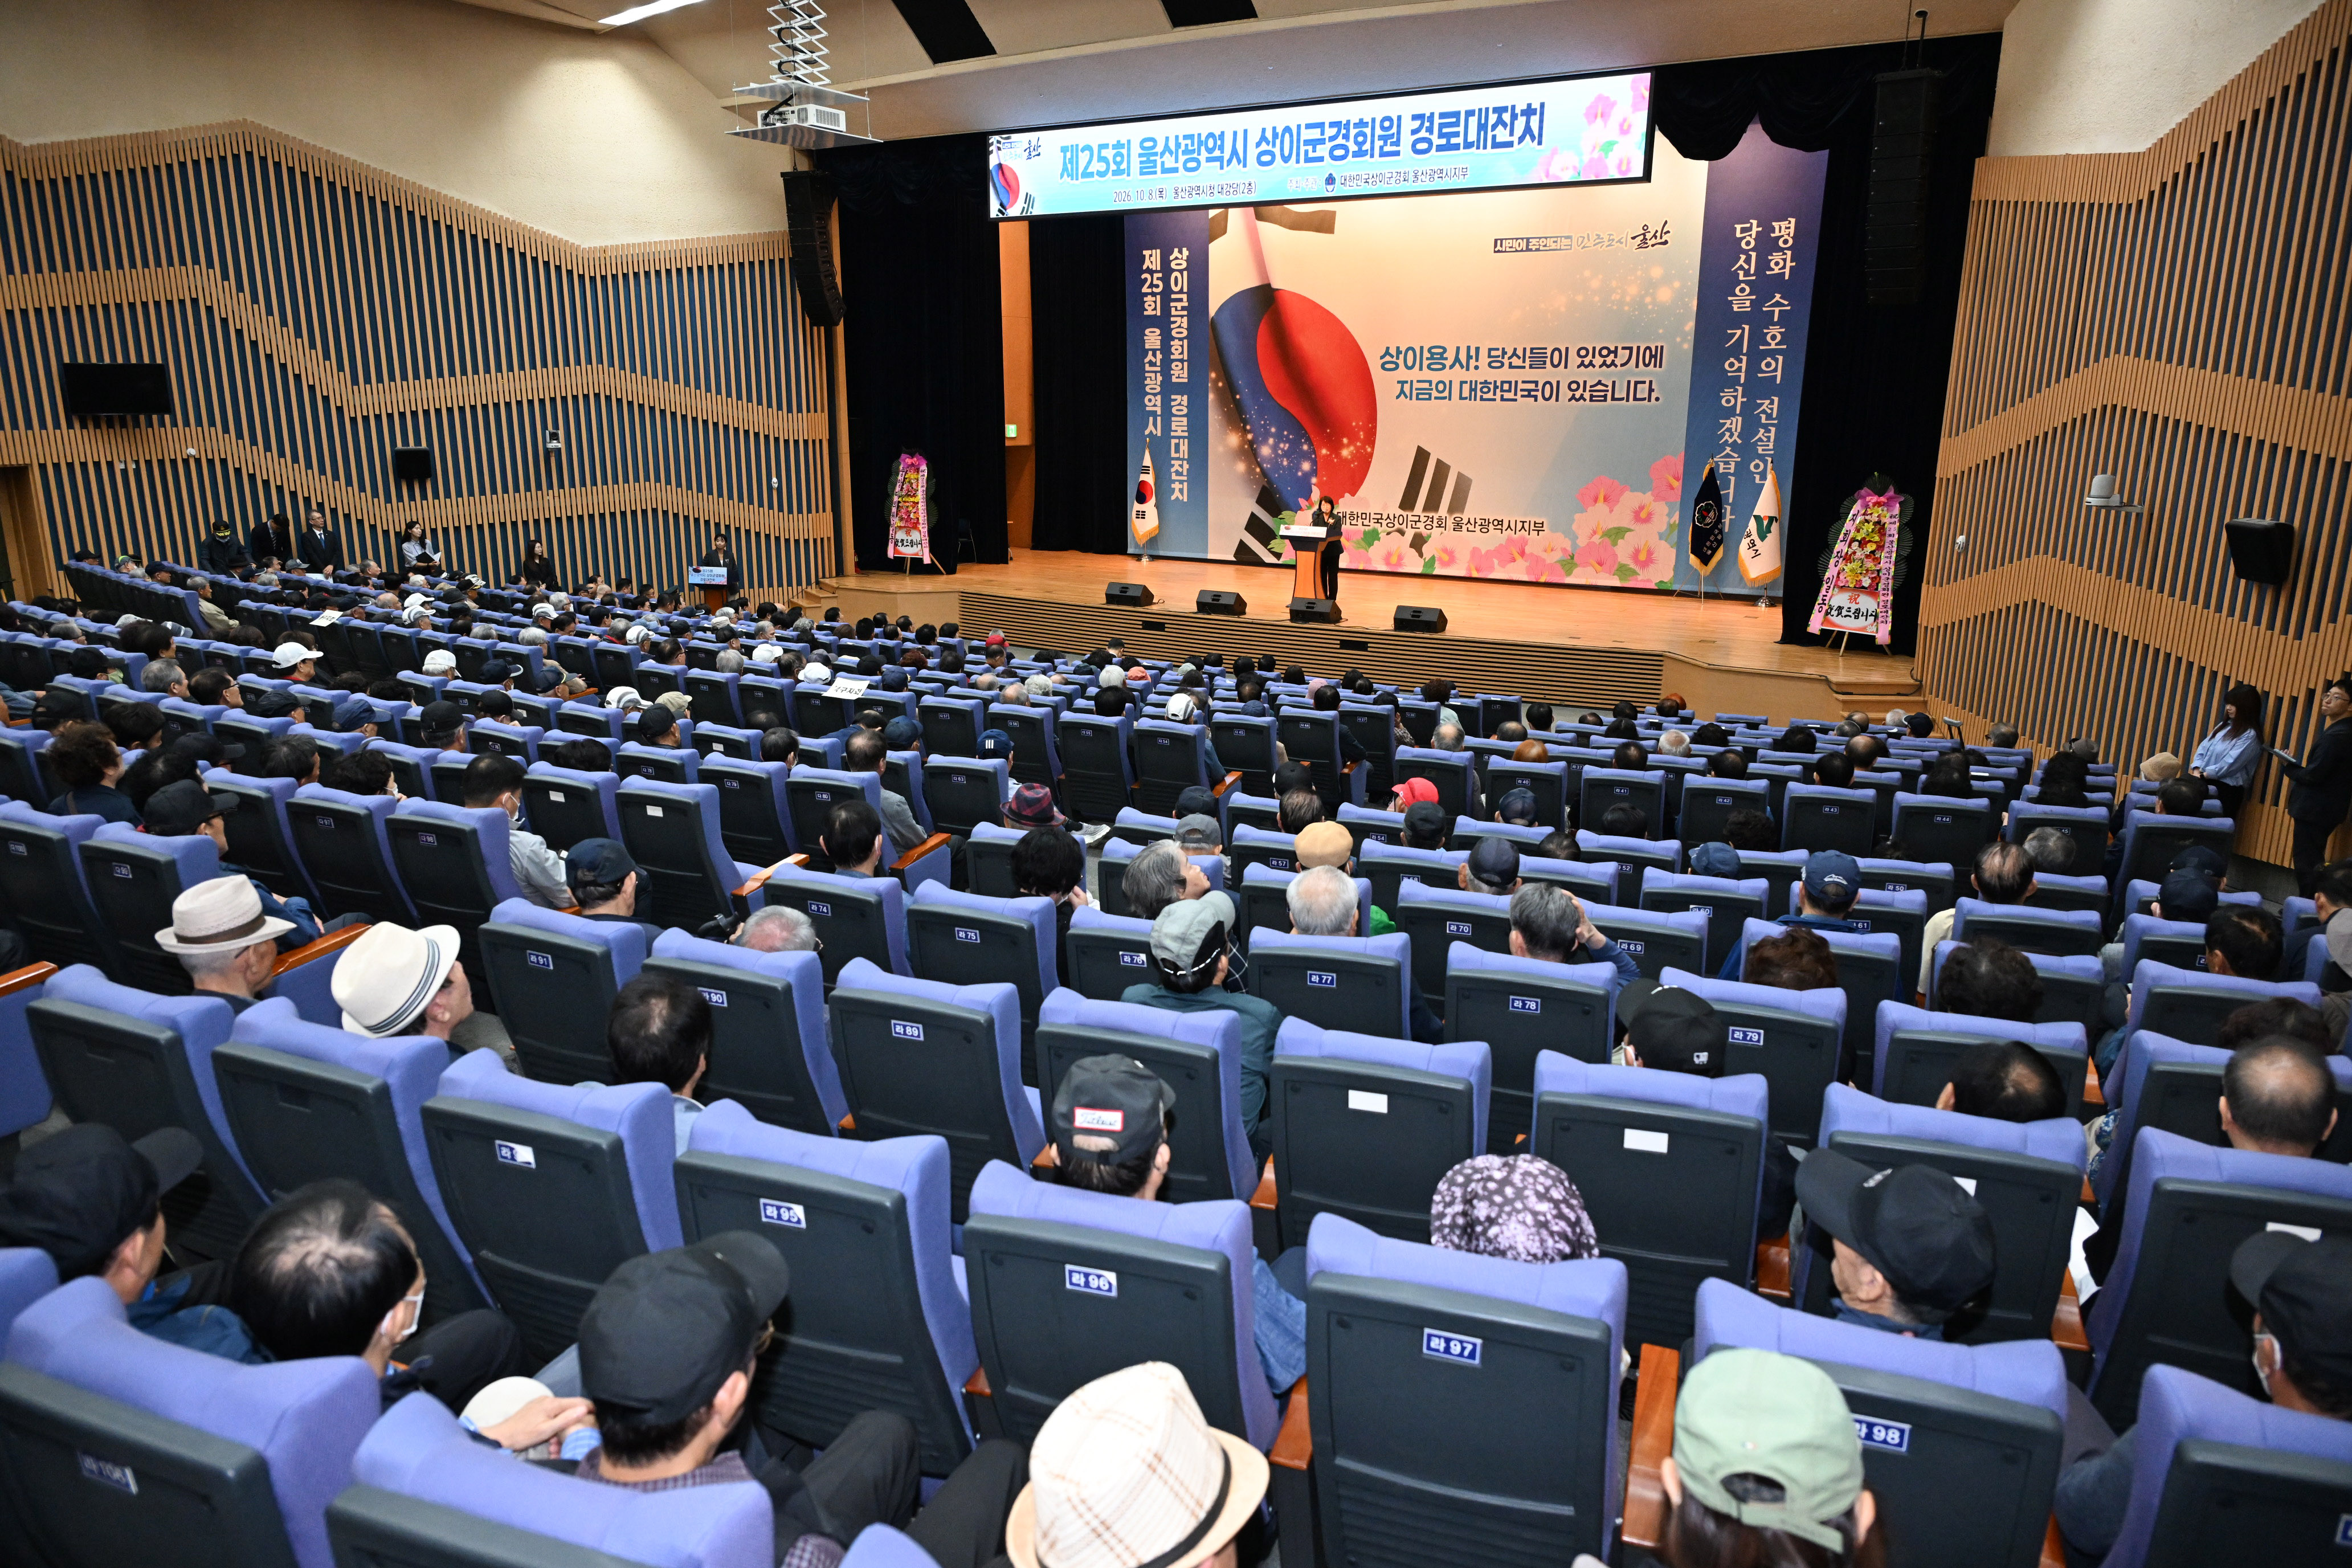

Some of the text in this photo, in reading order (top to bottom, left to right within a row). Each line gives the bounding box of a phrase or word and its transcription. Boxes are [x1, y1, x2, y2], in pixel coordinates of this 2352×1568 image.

[1060, 102, 1546, 181] 제25회 울산광역시 상이군경회원 경로대잔치
[1340, 170, 1409, 187] 대한민국상이군경회
[1412, 166, 1468, 183] 울산광역시지부
[1114, 190, 1133, 202] 2026.
[1136, 189, 1146, 201] 10.
[1173, 183, 1215, 199] 울산광역시청
[1218, 181, 1256, 196] 대강당(2층)
[1494, 238, 1526, 251] 시민이
[1529, 236, 1572, 250] 주인되는
[1631, 219, 1671, 250] 울산
[1727, 219, 1762, 312] 당신을
[1141, 249, 1163, 436] 제25회 울산광역시
[1750, 218, 1796, 484] 평화 수호의 전설인
[1379, 345, 1664, 372] 상이용사! 당신들이 있었기에
[1170, 247, 1189, 502] 상이군경회원 경로대잔치
[1395, 379, 1661, 403] 지금의 대한민국이 있습니다.
[1338, 511, 1546, 537] 대한민국상이군경회 울산광역시지부
[1884, 540, 1895, 565] 울산광역시
[1881, 567, 1892, 598] 상이군경회원
[1847, 593, 1860, 605] 祝
[1880, 599, 1889, 624] 경로대잔치
[538, 957, 548, 965] 91
[711, 993, 722, 1002] 90
[896, 1025, 918, 1036] 라 89
[1734, 1031, 1758, 1041] 라 79
[766, 1206, 798, 1223] 라 95
[1071, 1272, 1109, 1291] 라 96
[1430, 1337, 1473, 1357] 라 97
[1872, 1426, 1900, 1444] 98
